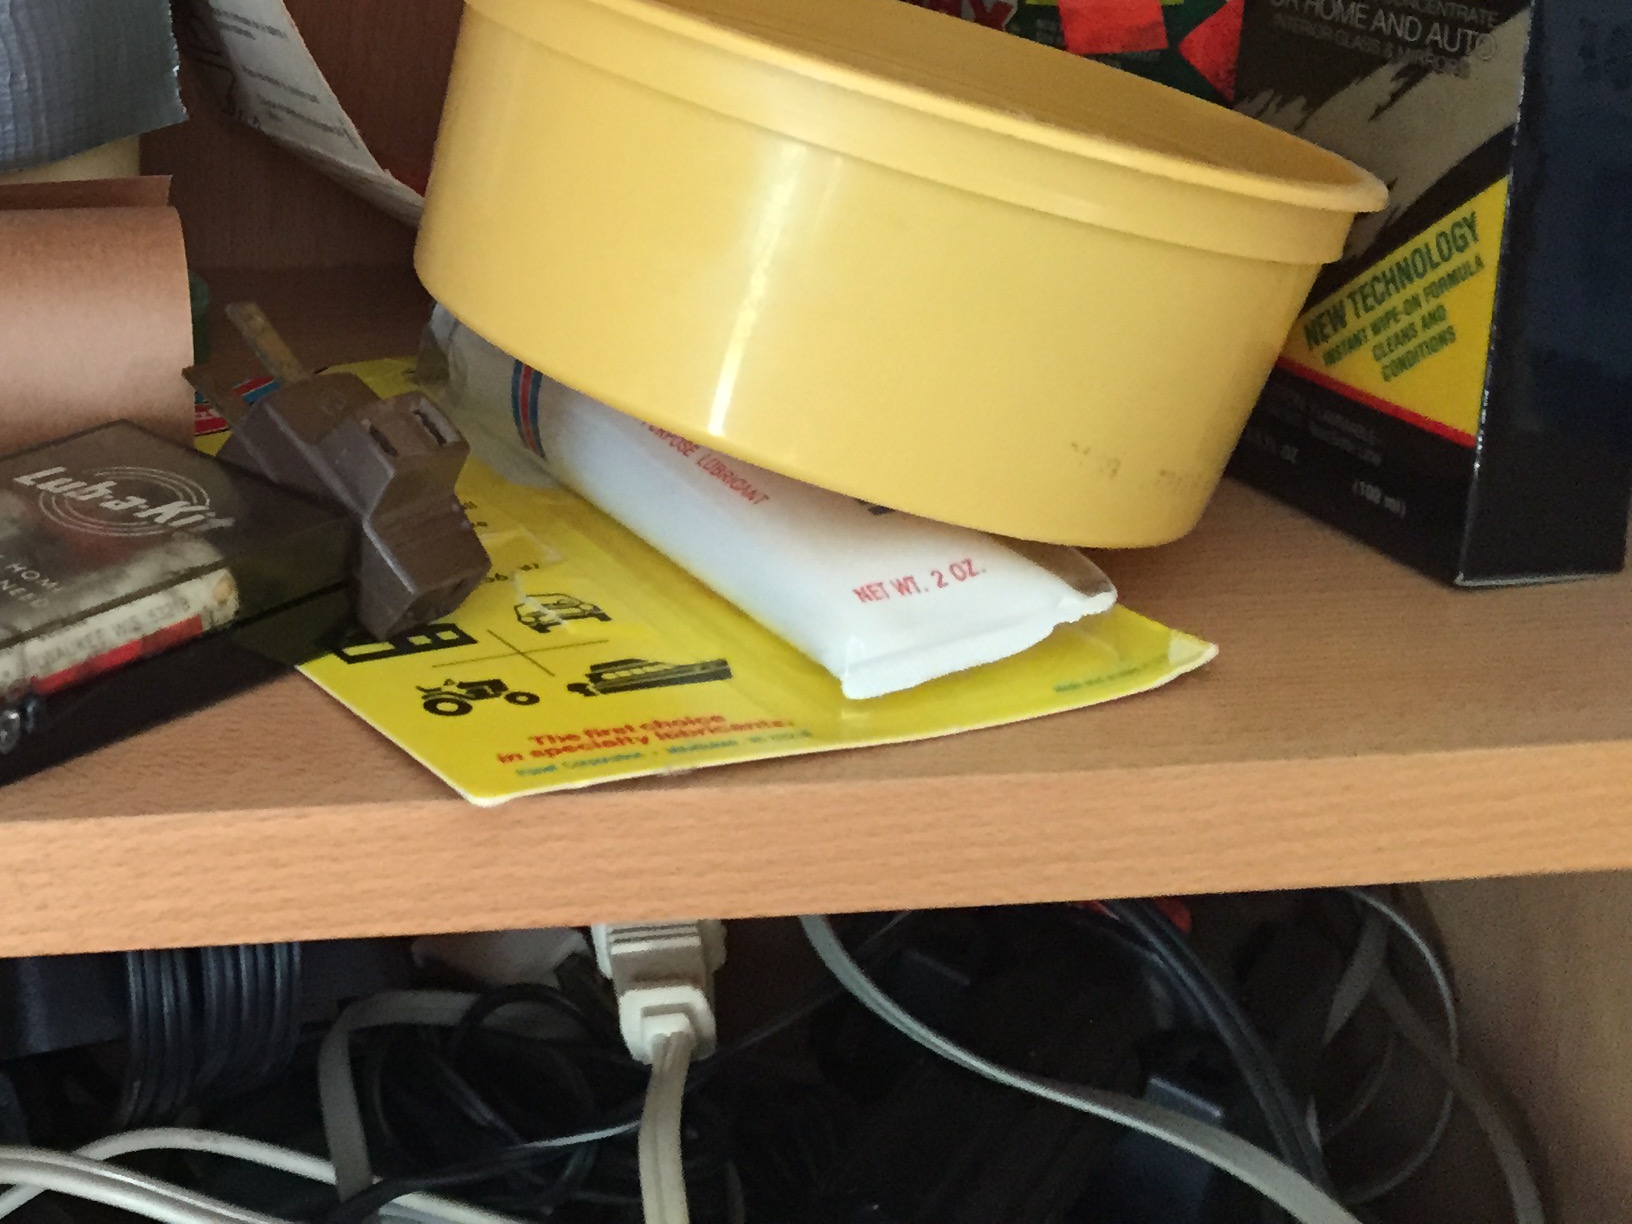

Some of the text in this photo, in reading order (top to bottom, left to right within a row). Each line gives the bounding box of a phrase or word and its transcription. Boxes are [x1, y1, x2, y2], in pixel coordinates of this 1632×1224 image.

[1370, 9, 1422, 42] AND
[1425, 22, 1496, 61] AUTO
[1303, 211, 1480, 351] NEW TECHNOLOGY
[696, 453, 770, 505] LUBRICANT
[852, 558, 987, 603] NET WT. 2 OZ.
